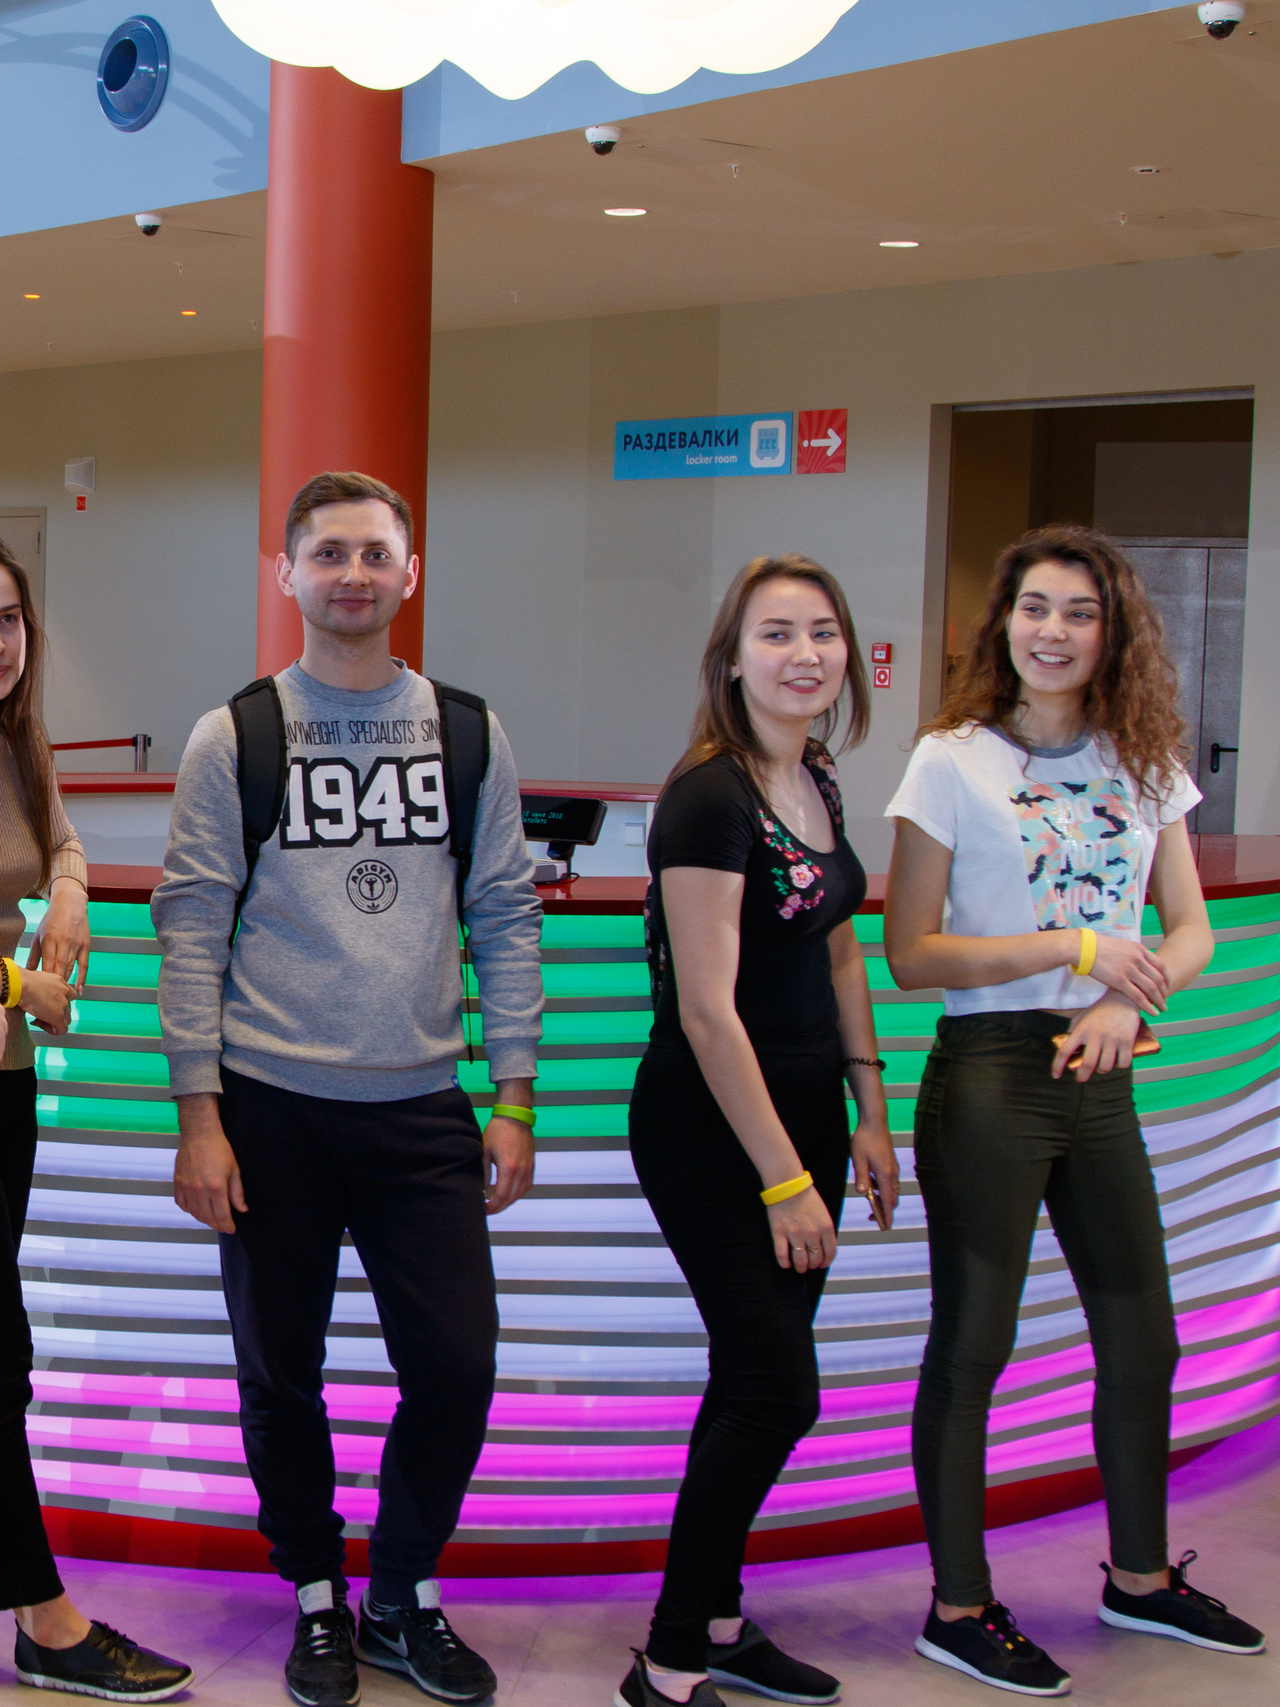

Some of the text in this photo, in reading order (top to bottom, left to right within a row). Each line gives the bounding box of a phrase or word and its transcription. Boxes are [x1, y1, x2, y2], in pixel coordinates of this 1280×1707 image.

[623, 429, 739, 452] РАЗДЕВАЛКИ
[685, 454, 738, 465] locker room
[348, 720, 416, 744] SPECIALISTS
[280, 754, 450, 849] 1949
[1057, 797, 1094, 823] DO
[1061, 840, 1112, 869] NOT
[351, 864, 393, 884] ADIGYM
[1058, 885, 1120, 914] HIDE
